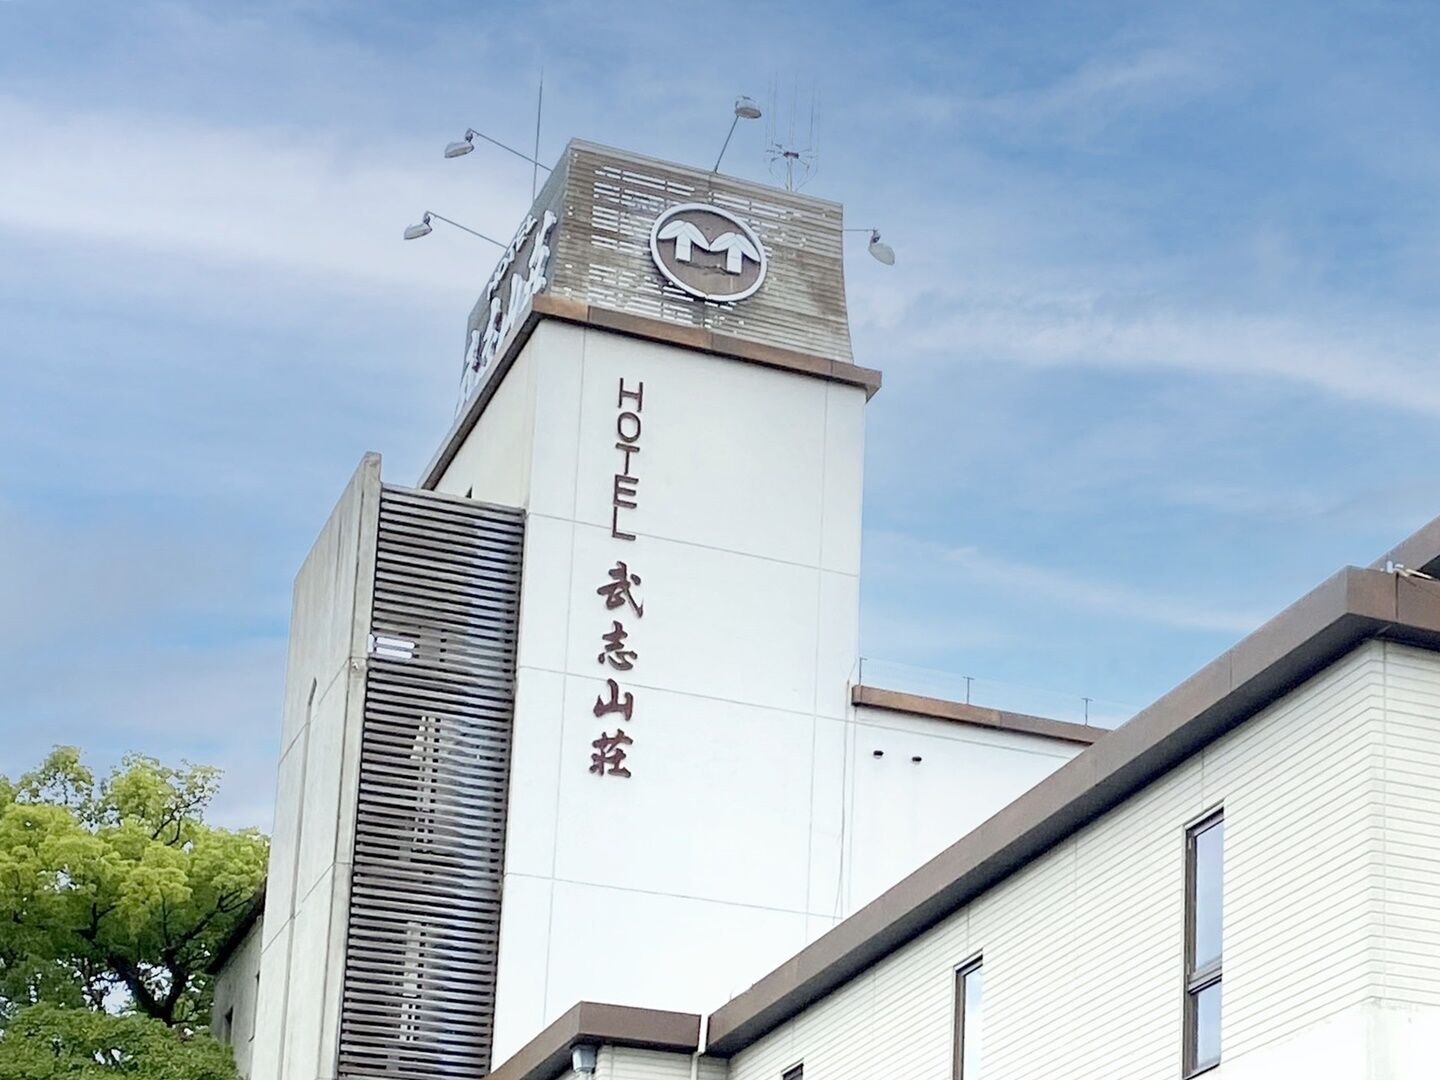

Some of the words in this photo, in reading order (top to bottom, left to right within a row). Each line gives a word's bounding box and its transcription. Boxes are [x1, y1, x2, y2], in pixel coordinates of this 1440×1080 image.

[611, 377, 644, 542] HOTEL
[588, 560, 644, 779] 武志山荘
